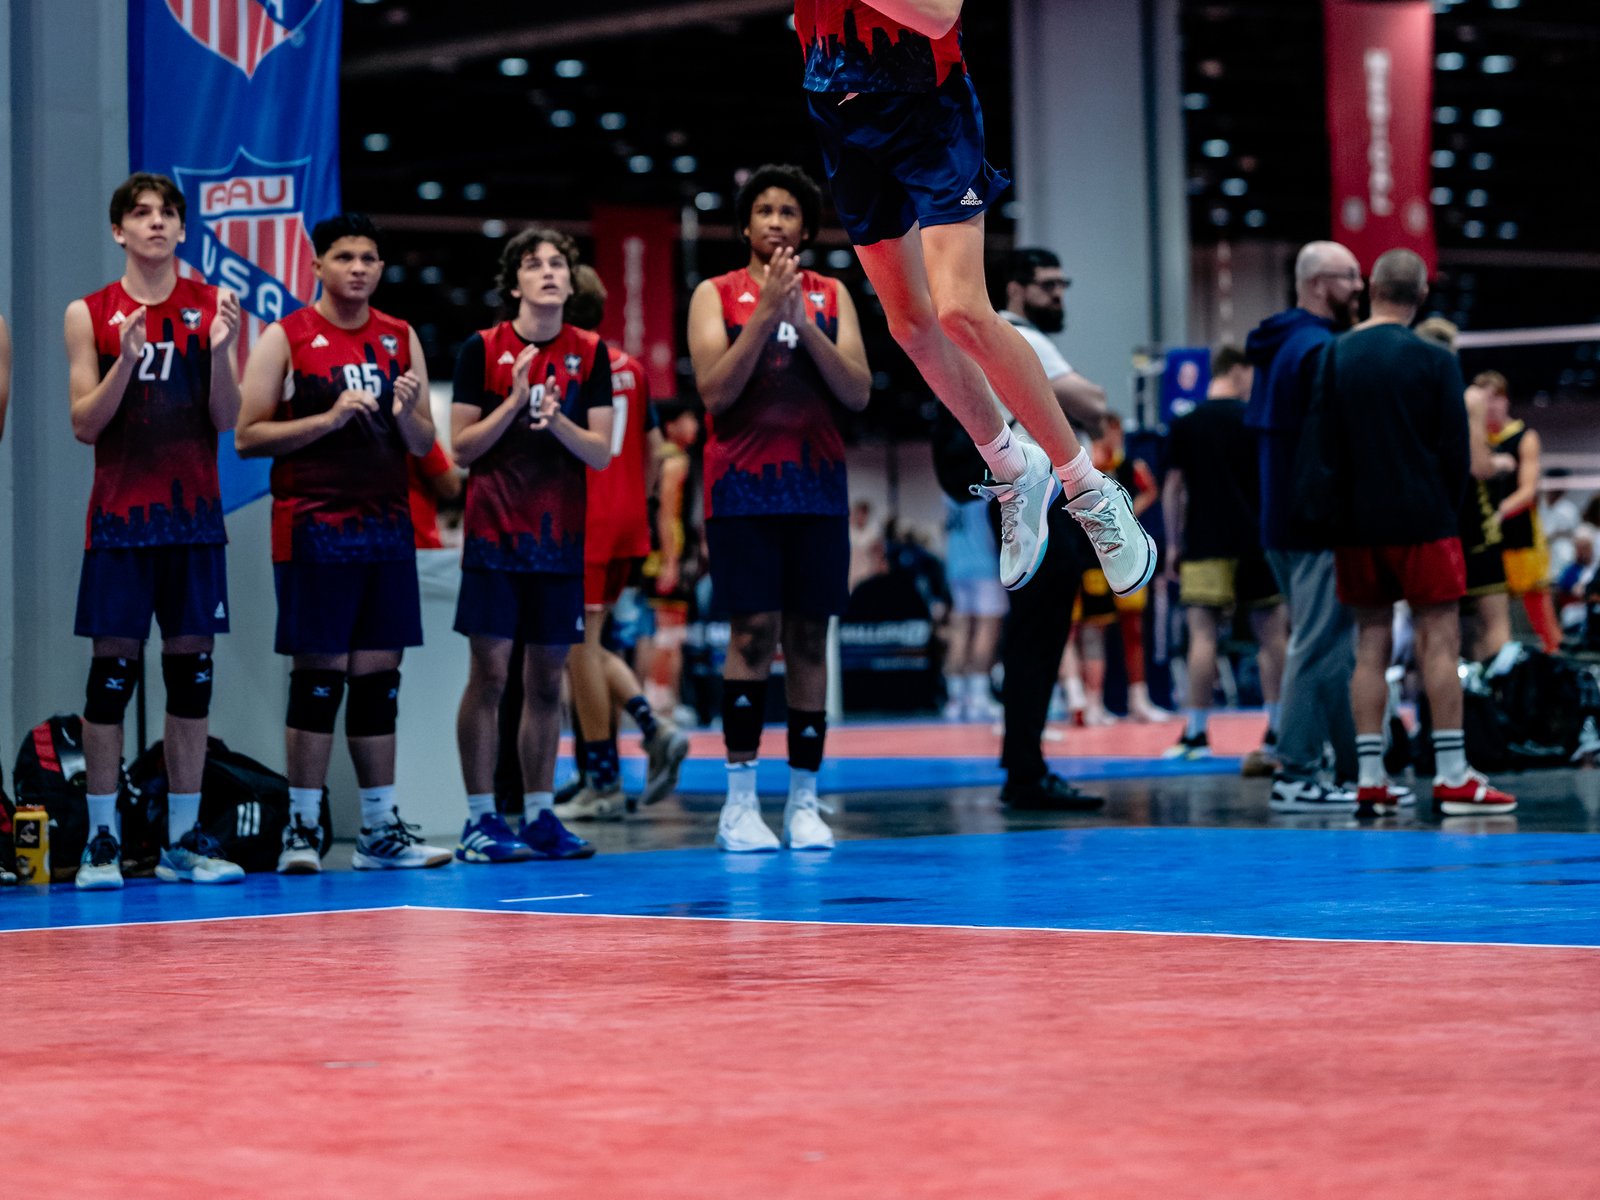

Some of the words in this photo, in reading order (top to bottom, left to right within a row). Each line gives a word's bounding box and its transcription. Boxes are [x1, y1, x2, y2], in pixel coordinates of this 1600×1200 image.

[202, 233, 284, 322] USA
[776, 321, 799, 349] 4
[138, 341, 175, 381] 27
